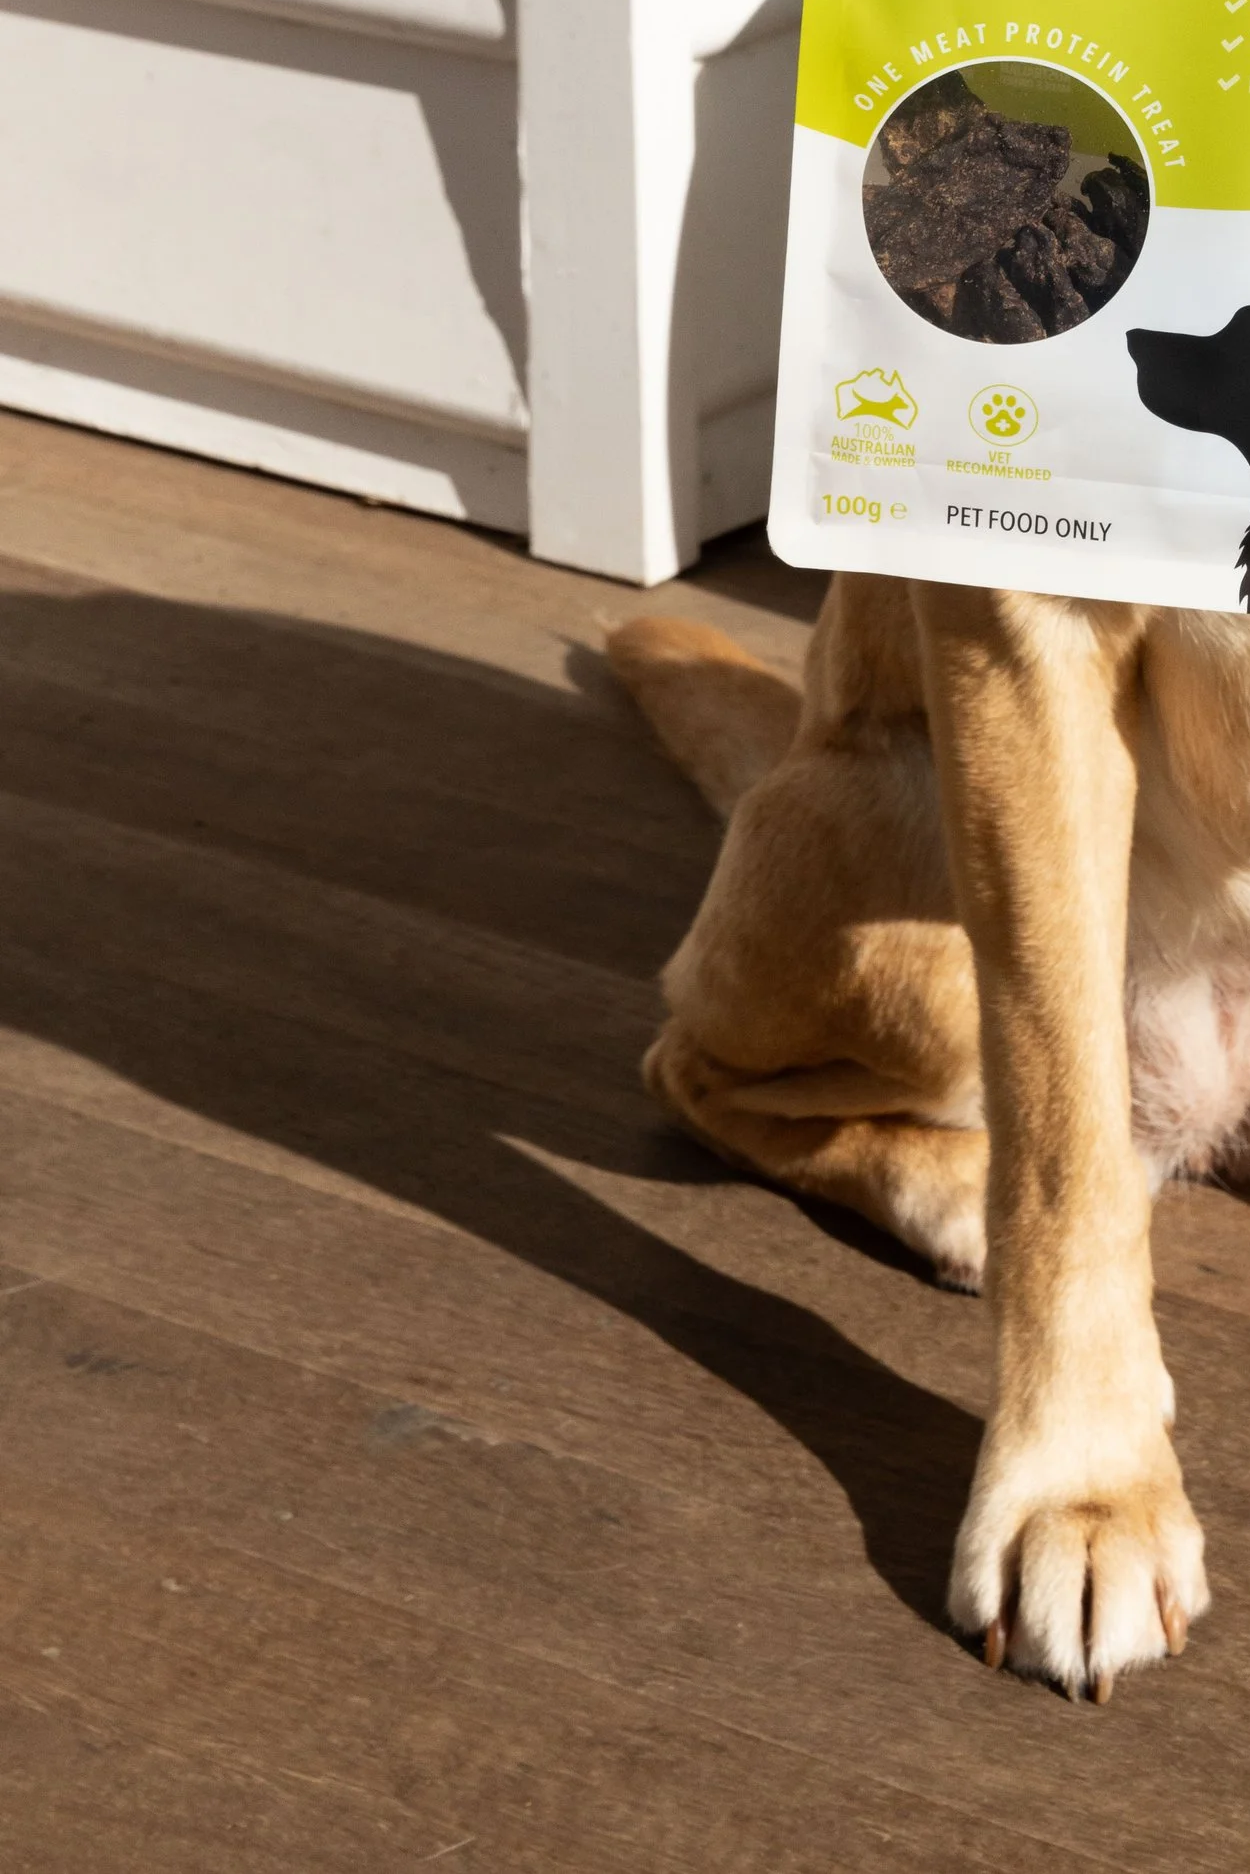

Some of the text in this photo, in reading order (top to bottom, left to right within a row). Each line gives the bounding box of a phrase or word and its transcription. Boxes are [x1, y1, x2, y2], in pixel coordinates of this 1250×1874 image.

[853, 62, 903, 112] ONE
[909, 22, 987, 66] MEAT
[1005, 21, 1130, 83] PROTEIN
[1131, 84, 1186, 169] TREAT
[853, 422, 895, 442] 100%
[831, 435, 916, 457] AUSTRALIAN
[831, 450, 861, 466] MADE
[874, 456, 916, 468] OWNED
[988, 450, 1012, 465] VET
[946, 459, 1052, 481] RECOMMENDED
[822, 494, 882, 524] 100g
[946, 505, 1112, 542] PET FOOD ONLY
